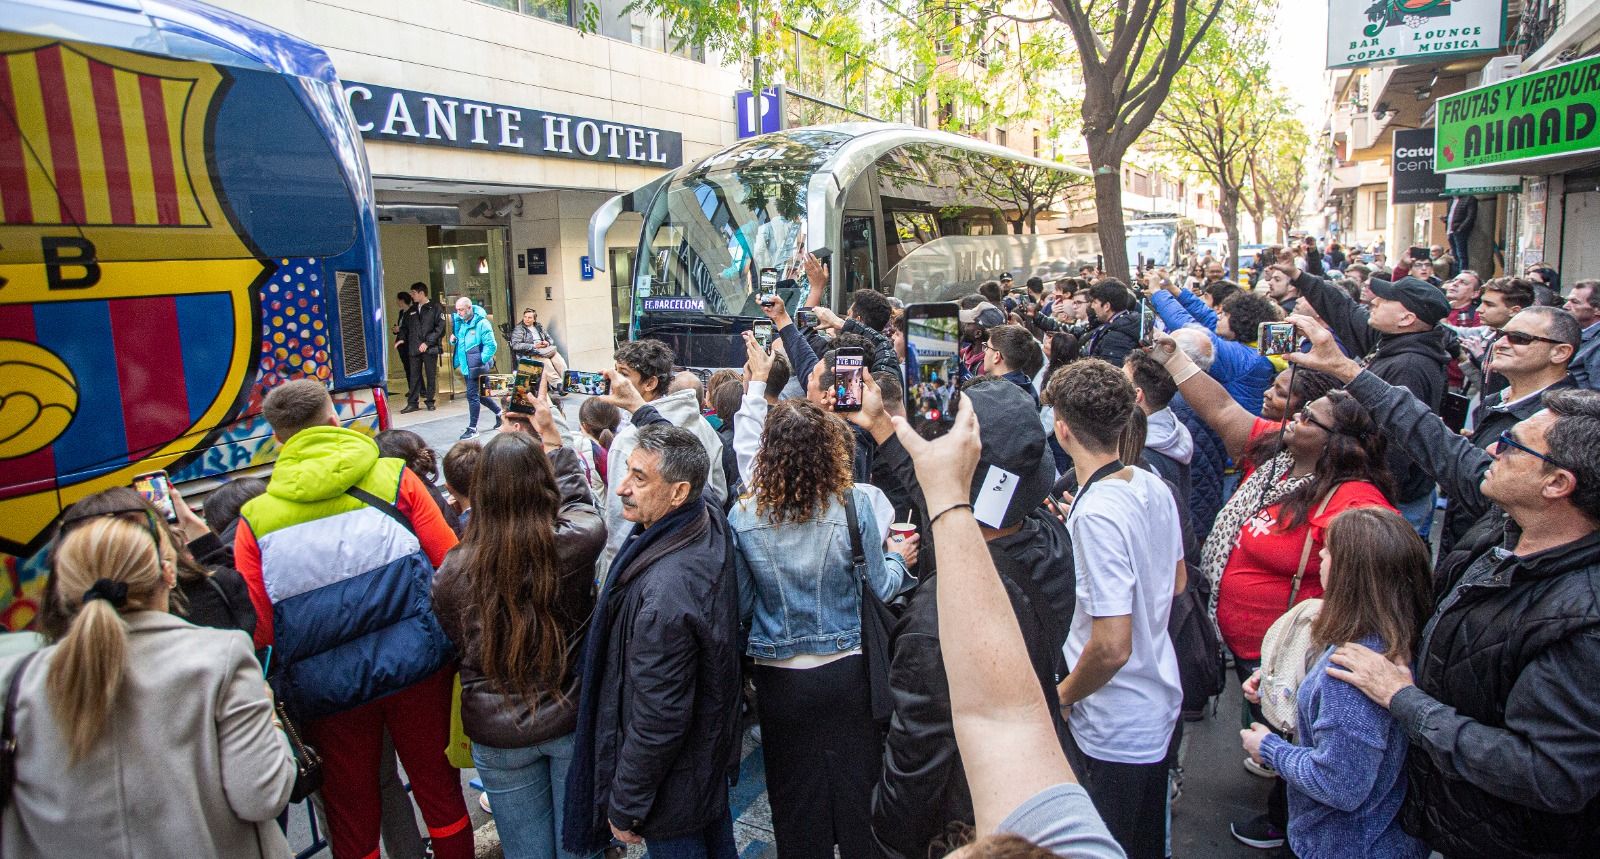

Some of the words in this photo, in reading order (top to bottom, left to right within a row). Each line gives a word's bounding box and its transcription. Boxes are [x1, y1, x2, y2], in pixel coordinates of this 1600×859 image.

[1413, 27, 1481, 41] LOUNGE
[1349, 38, 1379, 50] BAR
[1418, 40, 1480, 52] MUSICA
[1347, 48, 1395, 61] COPAS
[1442, 88, 1500, 125] FRUTAS
[1506, 84, 1518, 111] Y
[1521, 63, 1600, 107] VERDUR
[345, 86, 524, 148] CANTE
[542, 113, 667, 163] HOTEL
[1464, 102, 1597, 159] AHMAD
[1396, 146, 1434, 158] Catu
